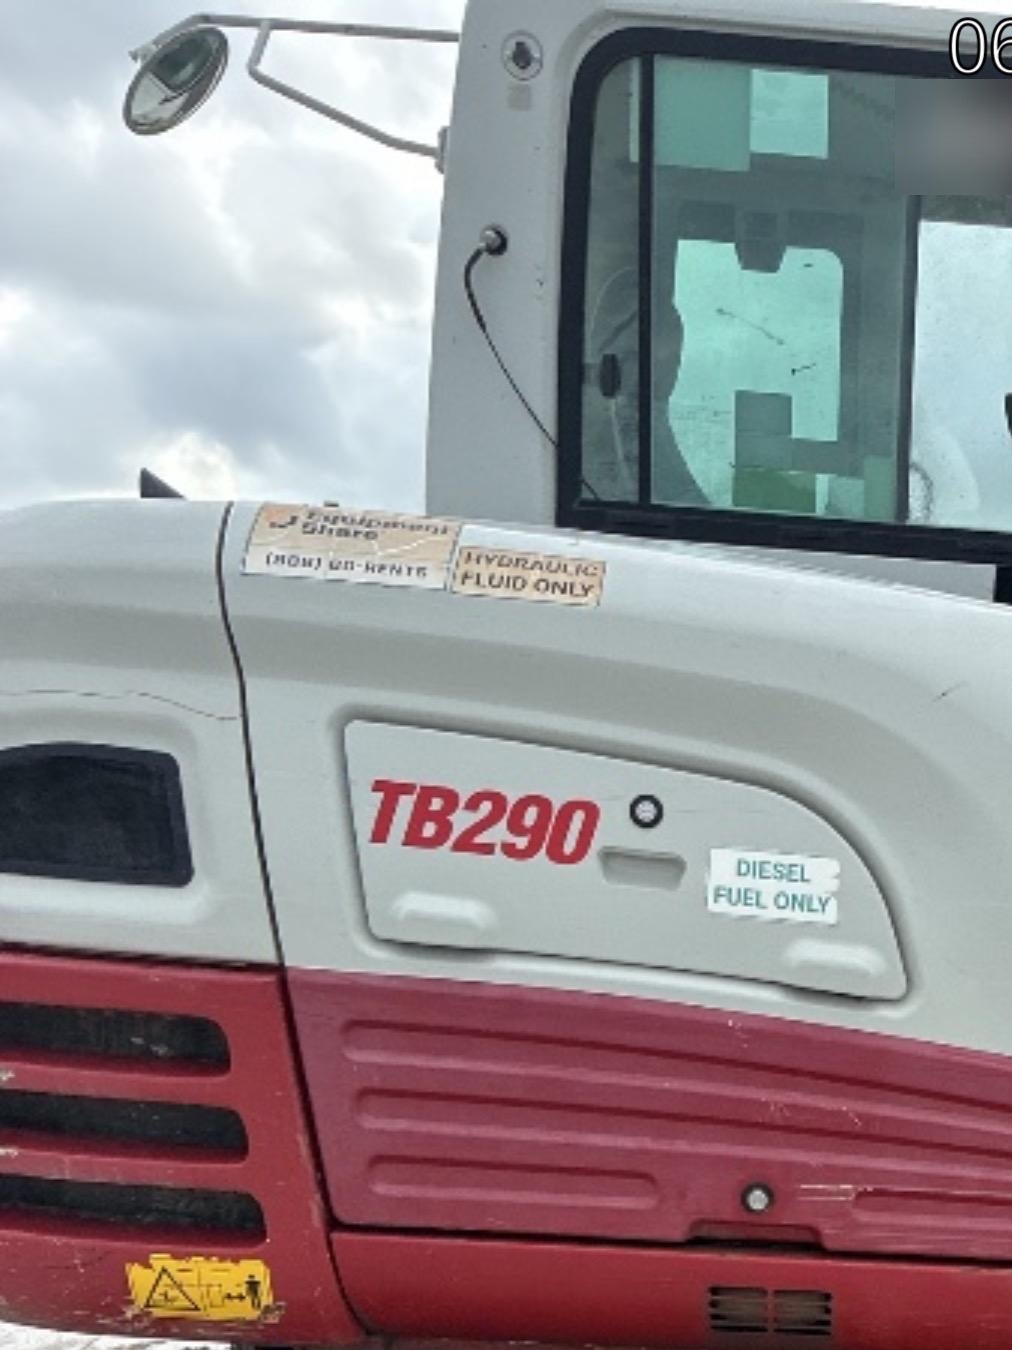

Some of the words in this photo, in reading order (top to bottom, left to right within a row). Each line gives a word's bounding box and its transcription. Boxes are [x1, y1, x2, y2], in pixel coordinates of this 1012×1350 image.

[464, 551, 598, 577] HYDRAULIC
[461, 571, 527, 591] FLUID
[533, 578, 595, 598] ONLY
[369, 779, 600, 864] TB290
[736, 858, 811, 883] DIESEL
[713, 886, 768, 909] FUEL
[773, 890, 832, 914] ONLY
